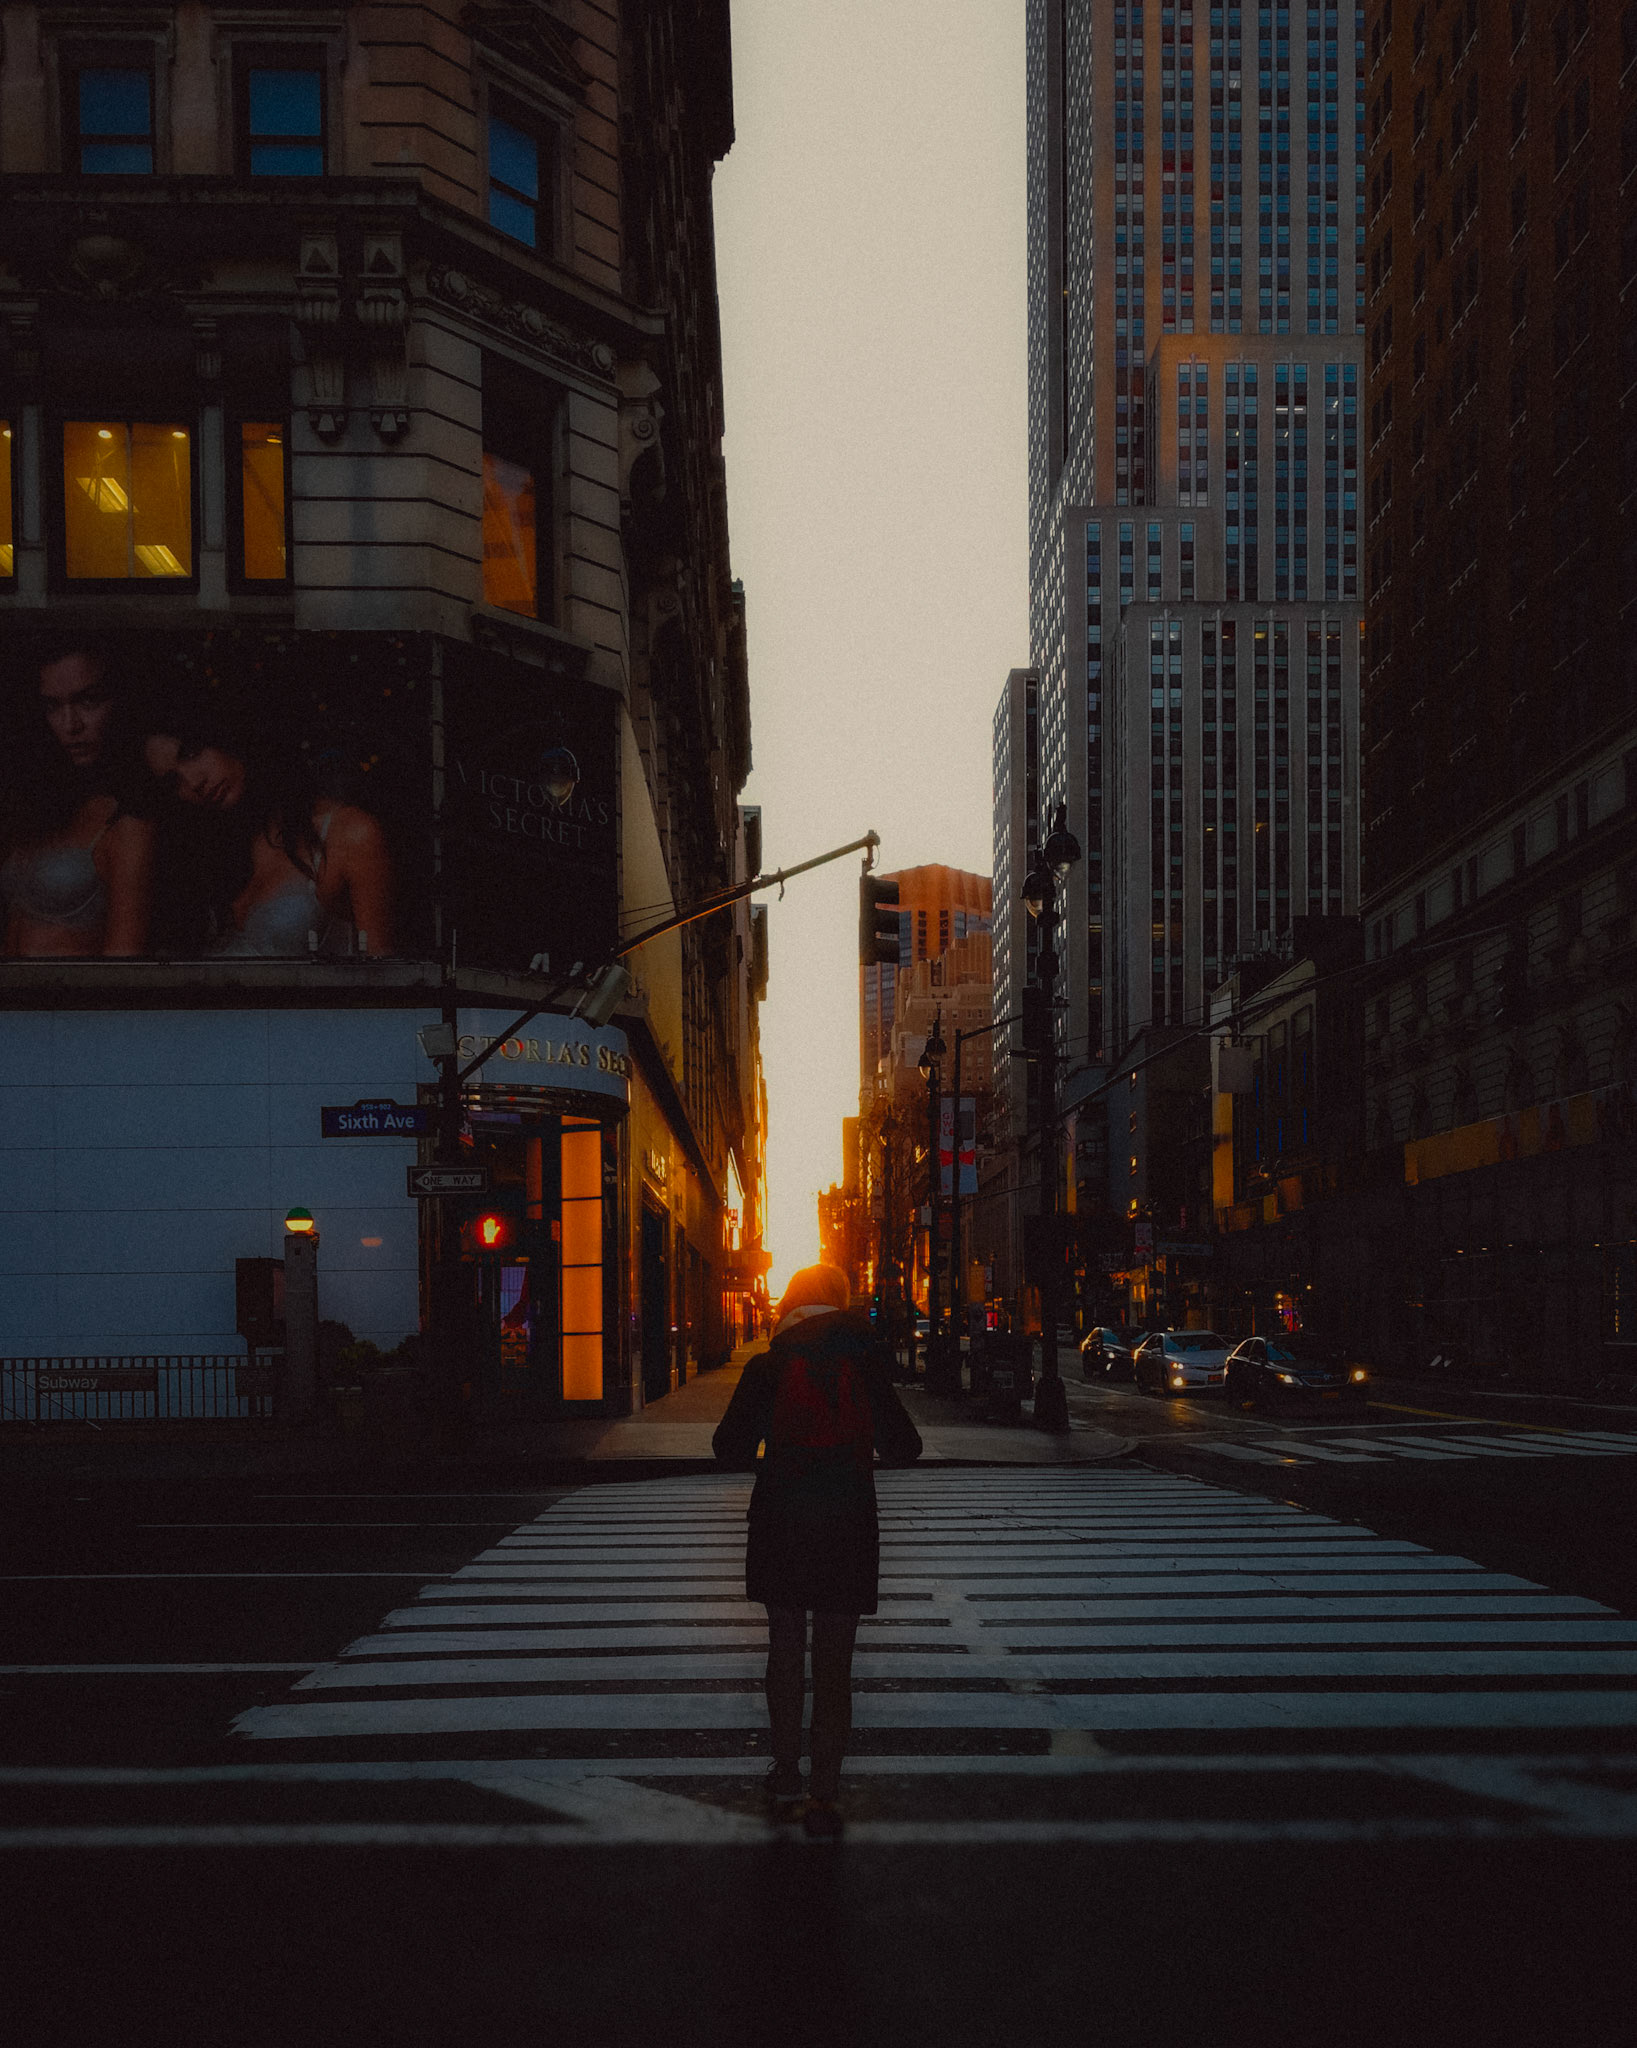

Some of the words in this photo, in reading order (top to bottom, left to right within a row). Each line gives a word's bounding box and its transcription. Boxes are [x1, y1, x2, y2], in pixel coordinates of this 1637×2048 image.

[489, 801, 587, 849] SECRET
[416, 1031, 590, 1067] CTORIA'S
[596, 1044, 631, 1078] SEC
[338, 1112, 379, 1130] Sixth
[383, 1113, 415, 1130] Ave
[422, 1176, 443, 1186] ONE
[453, 1175, 475, 1186] WAY
[38, 1375, 98, 1391] Subway
